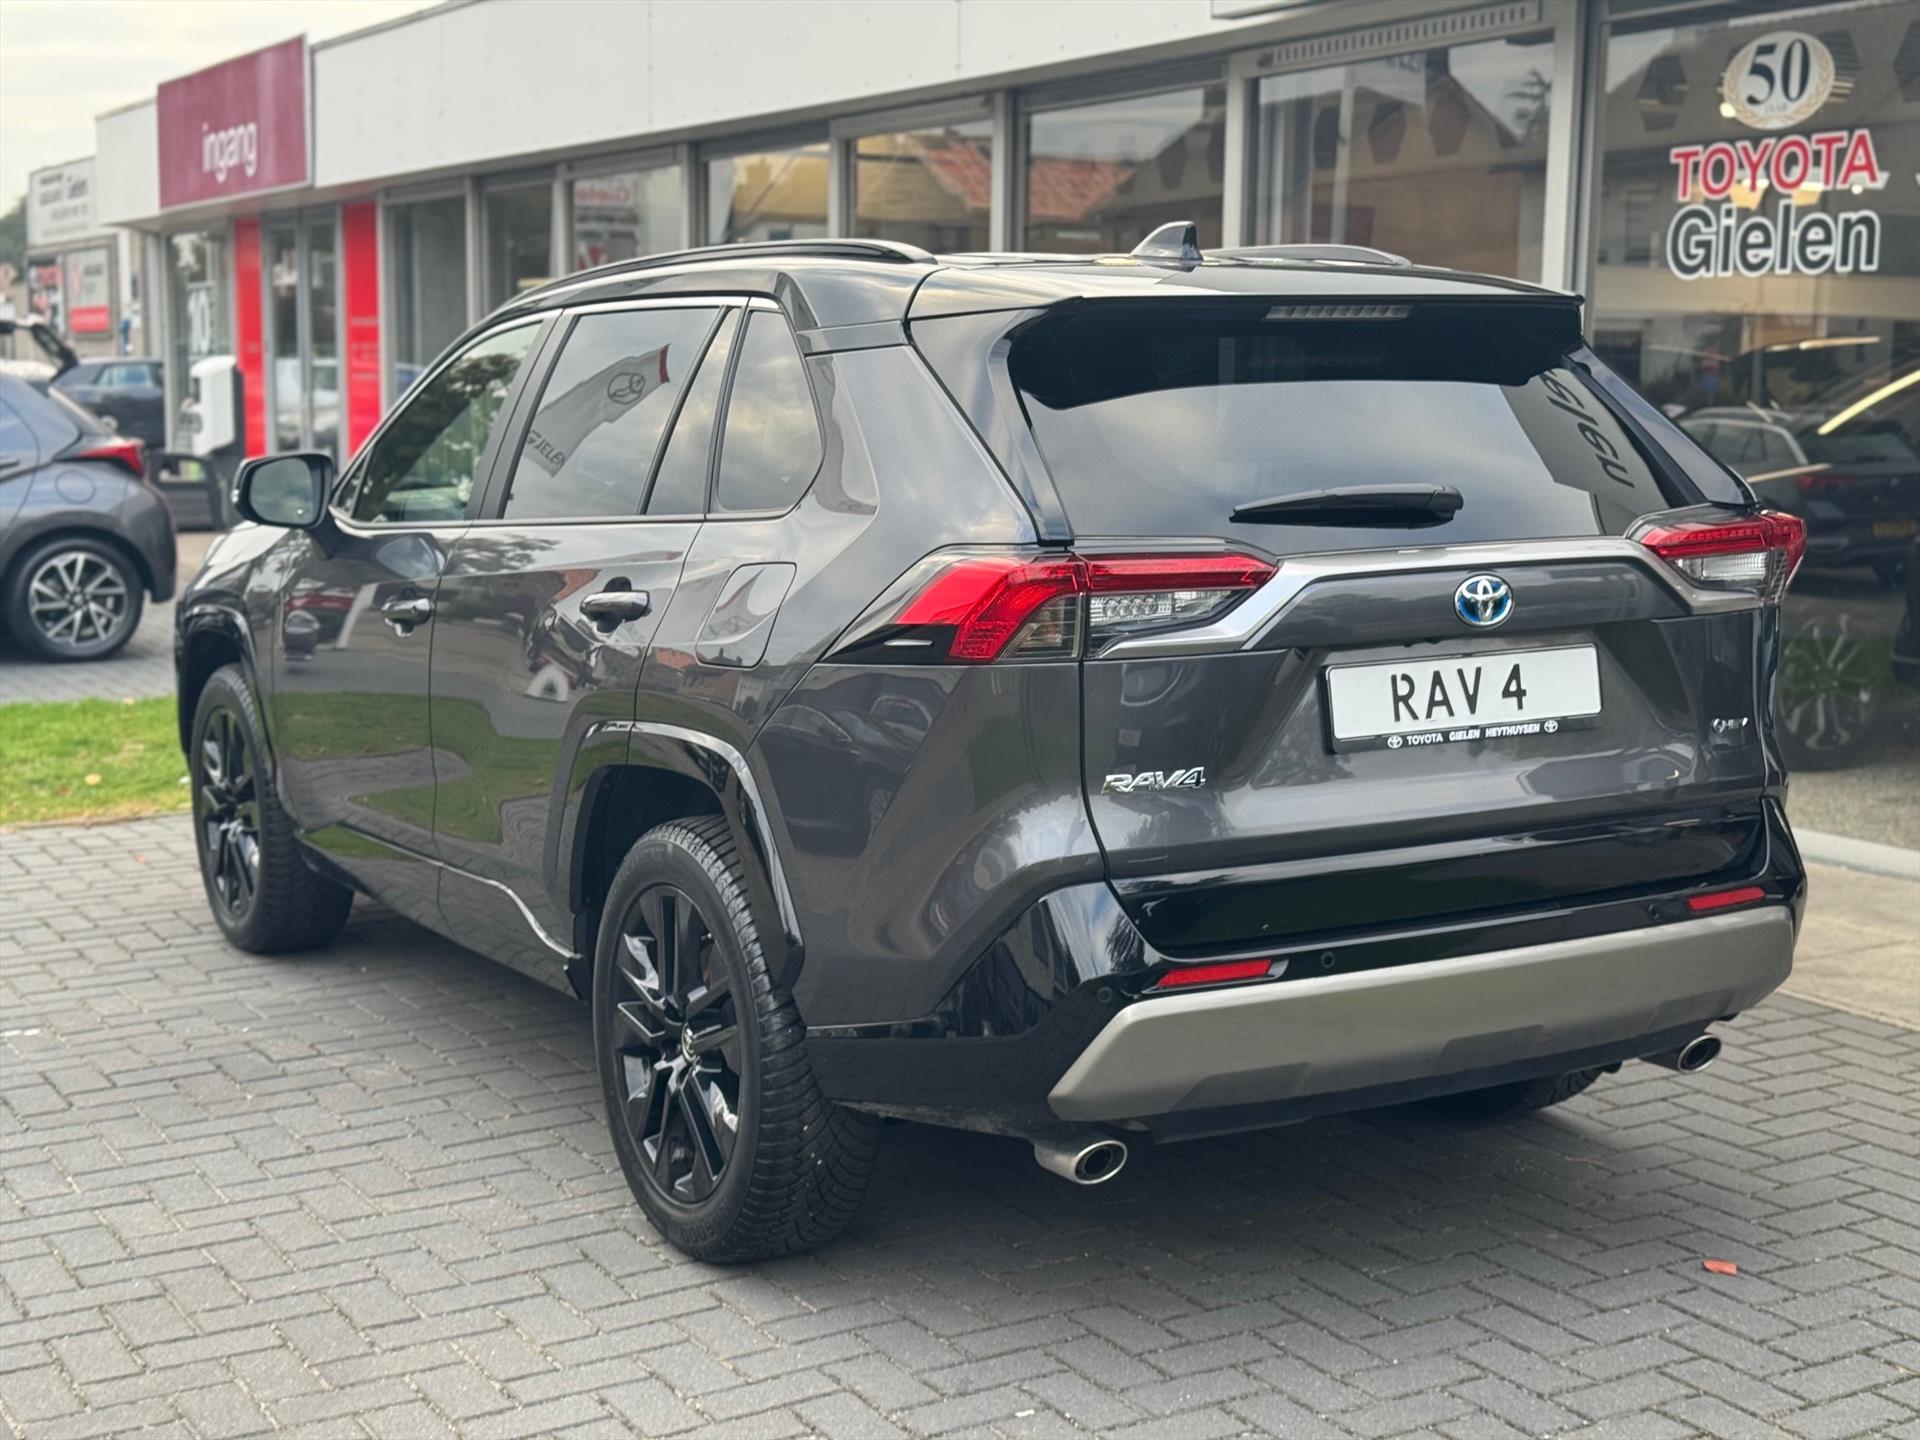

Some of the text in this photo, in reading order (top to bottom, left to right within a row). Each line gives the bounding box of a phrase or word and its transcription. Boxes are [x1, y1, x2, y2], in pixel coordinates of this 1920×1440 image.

[1746, 38, 1811, 105] 50
[202, 122, 257, 183] ingang
[1670, 129, 1881, 202] TOYOTA
[1666, 199, 1882, 280] Gielen
[1390, 663, 1527, 722] RAV 4
[1406, 723, 1540, 746] TOYOTA GIELEN HEYTHUYSEN
[1101, 767, 1206, 795] RAV4
